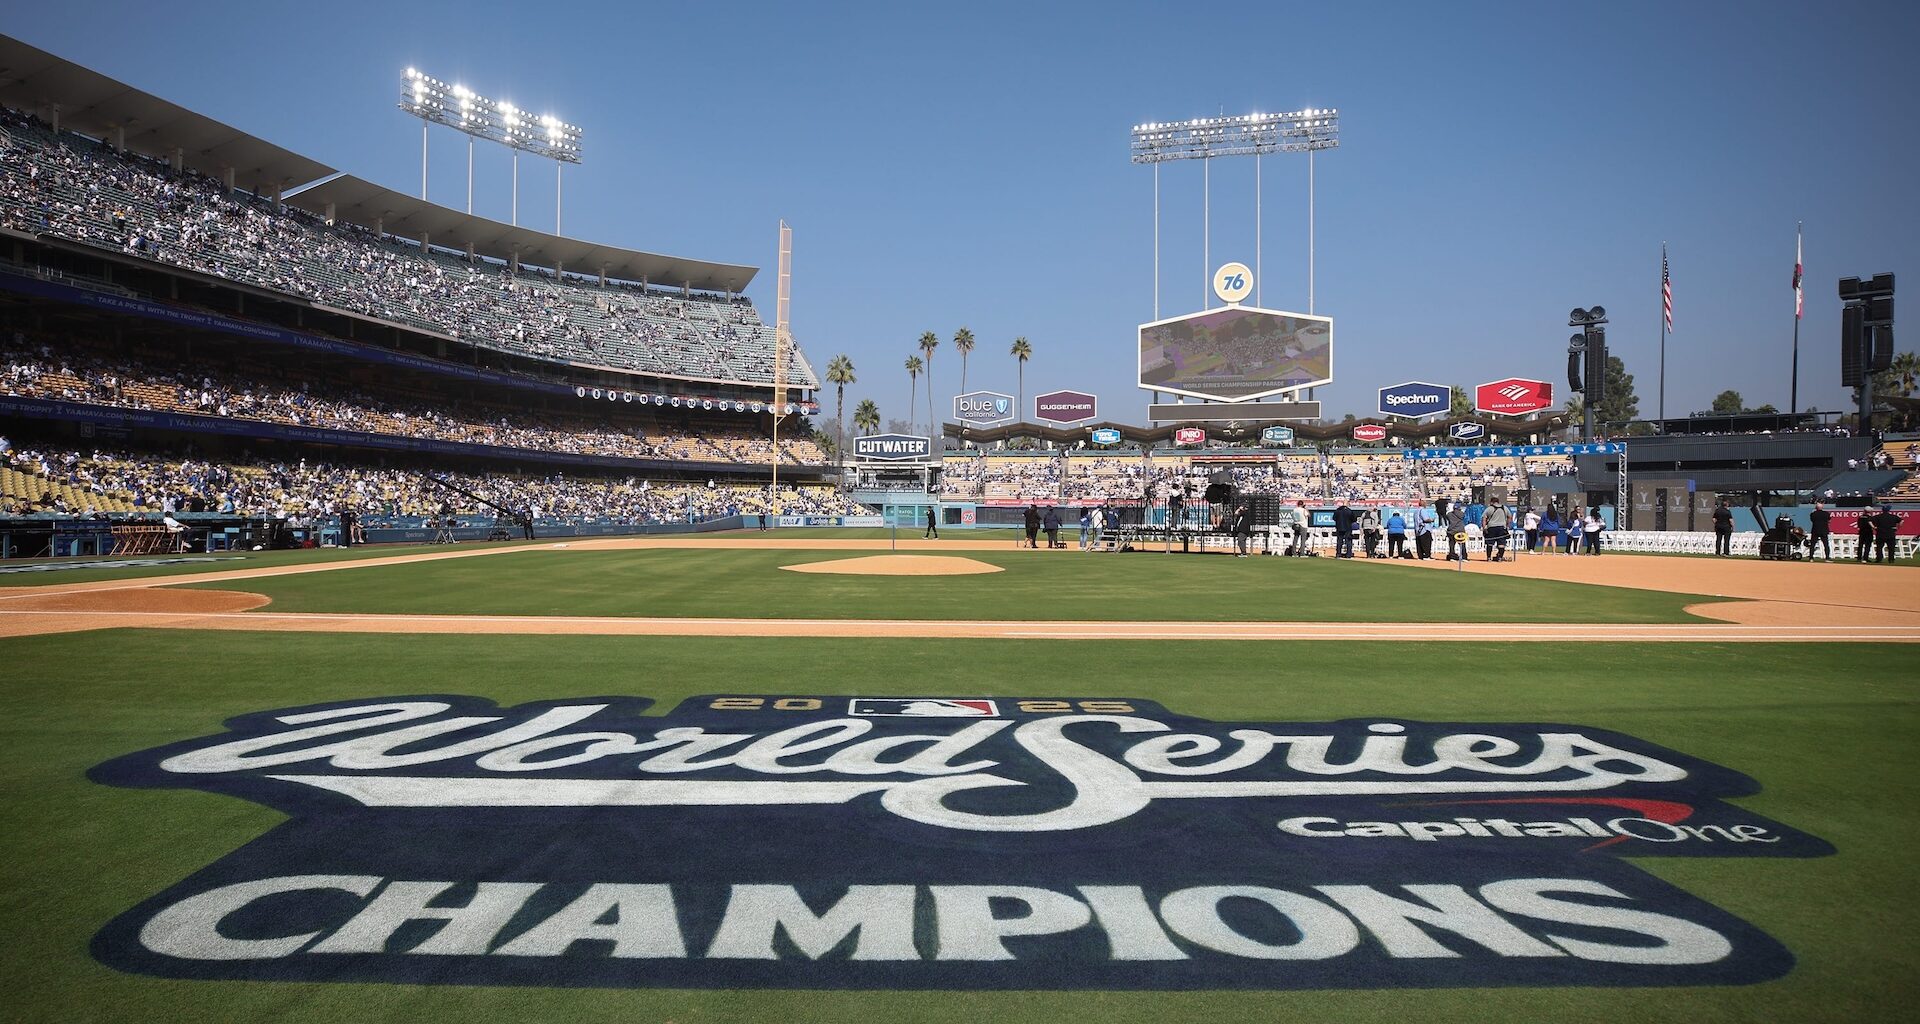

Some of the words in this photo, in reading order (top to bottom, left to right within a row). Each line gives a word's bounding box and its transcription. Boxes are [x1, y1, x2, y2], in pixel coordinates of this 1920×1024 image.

[1223, 273, 1245, 291] 76
[98, 296, 117, 306] TAKE
[125, 301, 137, 310] PIC
[147, 306, 165, 316] WITH
[167, 310, 179, 318] THE
[180, 312, 206, 323] TROPHY
[960, 398, 993, 412] blue
[1386, 393, 1439, 406] Spectrum
[19, 404, 53, 414] TROPHY
[964, 410, 997, 419] california
[1181, 430, 1200, 439] JINRO
[859, 440, 925, 453] CUTWATER
[1317, 515, 1335, 523] UCL
[709, 697, 823, 711] 20
[1016, 699, 1136, 713] 25
[159, 701, 1014, 776] World
[882, 715, 1690, 832] Series
[139, 876, 1733, 966] CHAMPIONS
